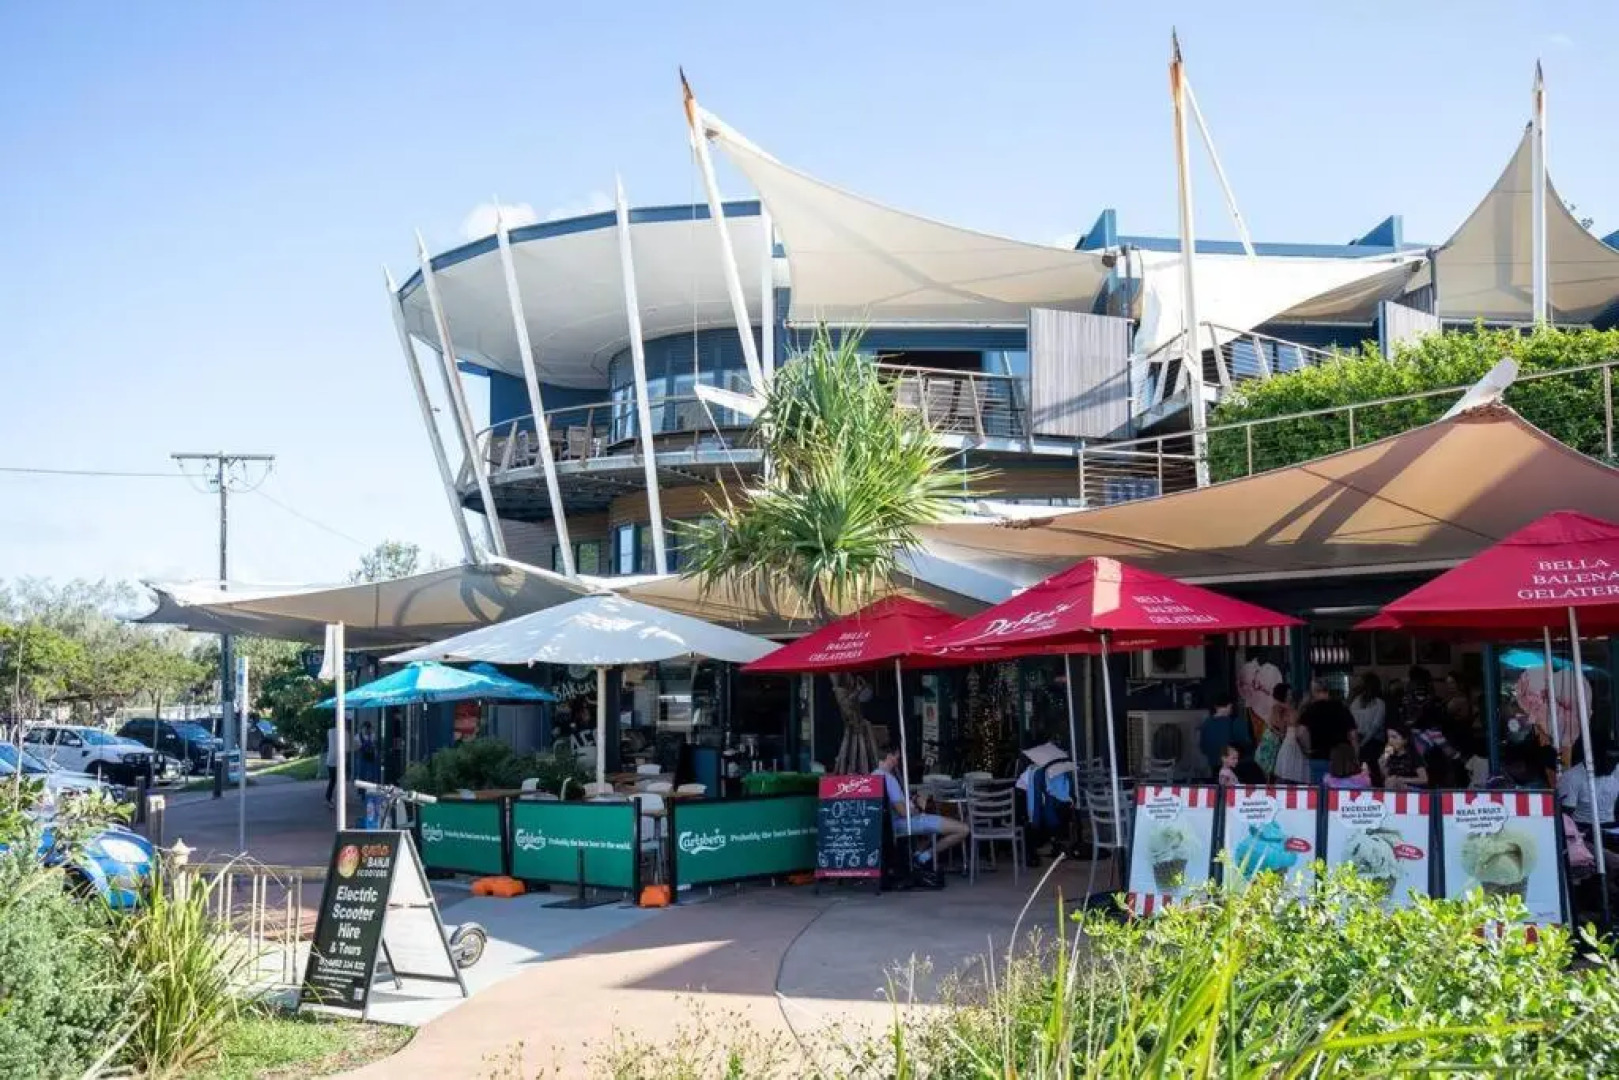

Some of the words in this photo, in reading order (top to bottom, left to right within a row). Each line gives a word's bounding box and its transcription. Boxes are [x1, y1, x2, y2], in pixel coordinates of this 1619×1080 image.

[1539, 559, 1611, 570] BELLA
[1533, 571, 1619, 584] BALENA
[1131, 595, 1174, 604] BELLA
[839, 631, 872, 641] BELLA
[1341, 804, 1381, 813] EXCELLENT
[1456, 808, 1476, 816] REAL
[1478, 807, 1502, 815] FRUIT
[515, 828, 546, 851] Carlsberg
[679, 828, 727, 855] Carlsberg
[730, 831, 761, 842] Probably
[336, 885, 379, 903] Electric
[331, 903, 376, 921] Scooter
[337, 922, 361, 939] Hire
[339, 941, 363, 956] Tours
